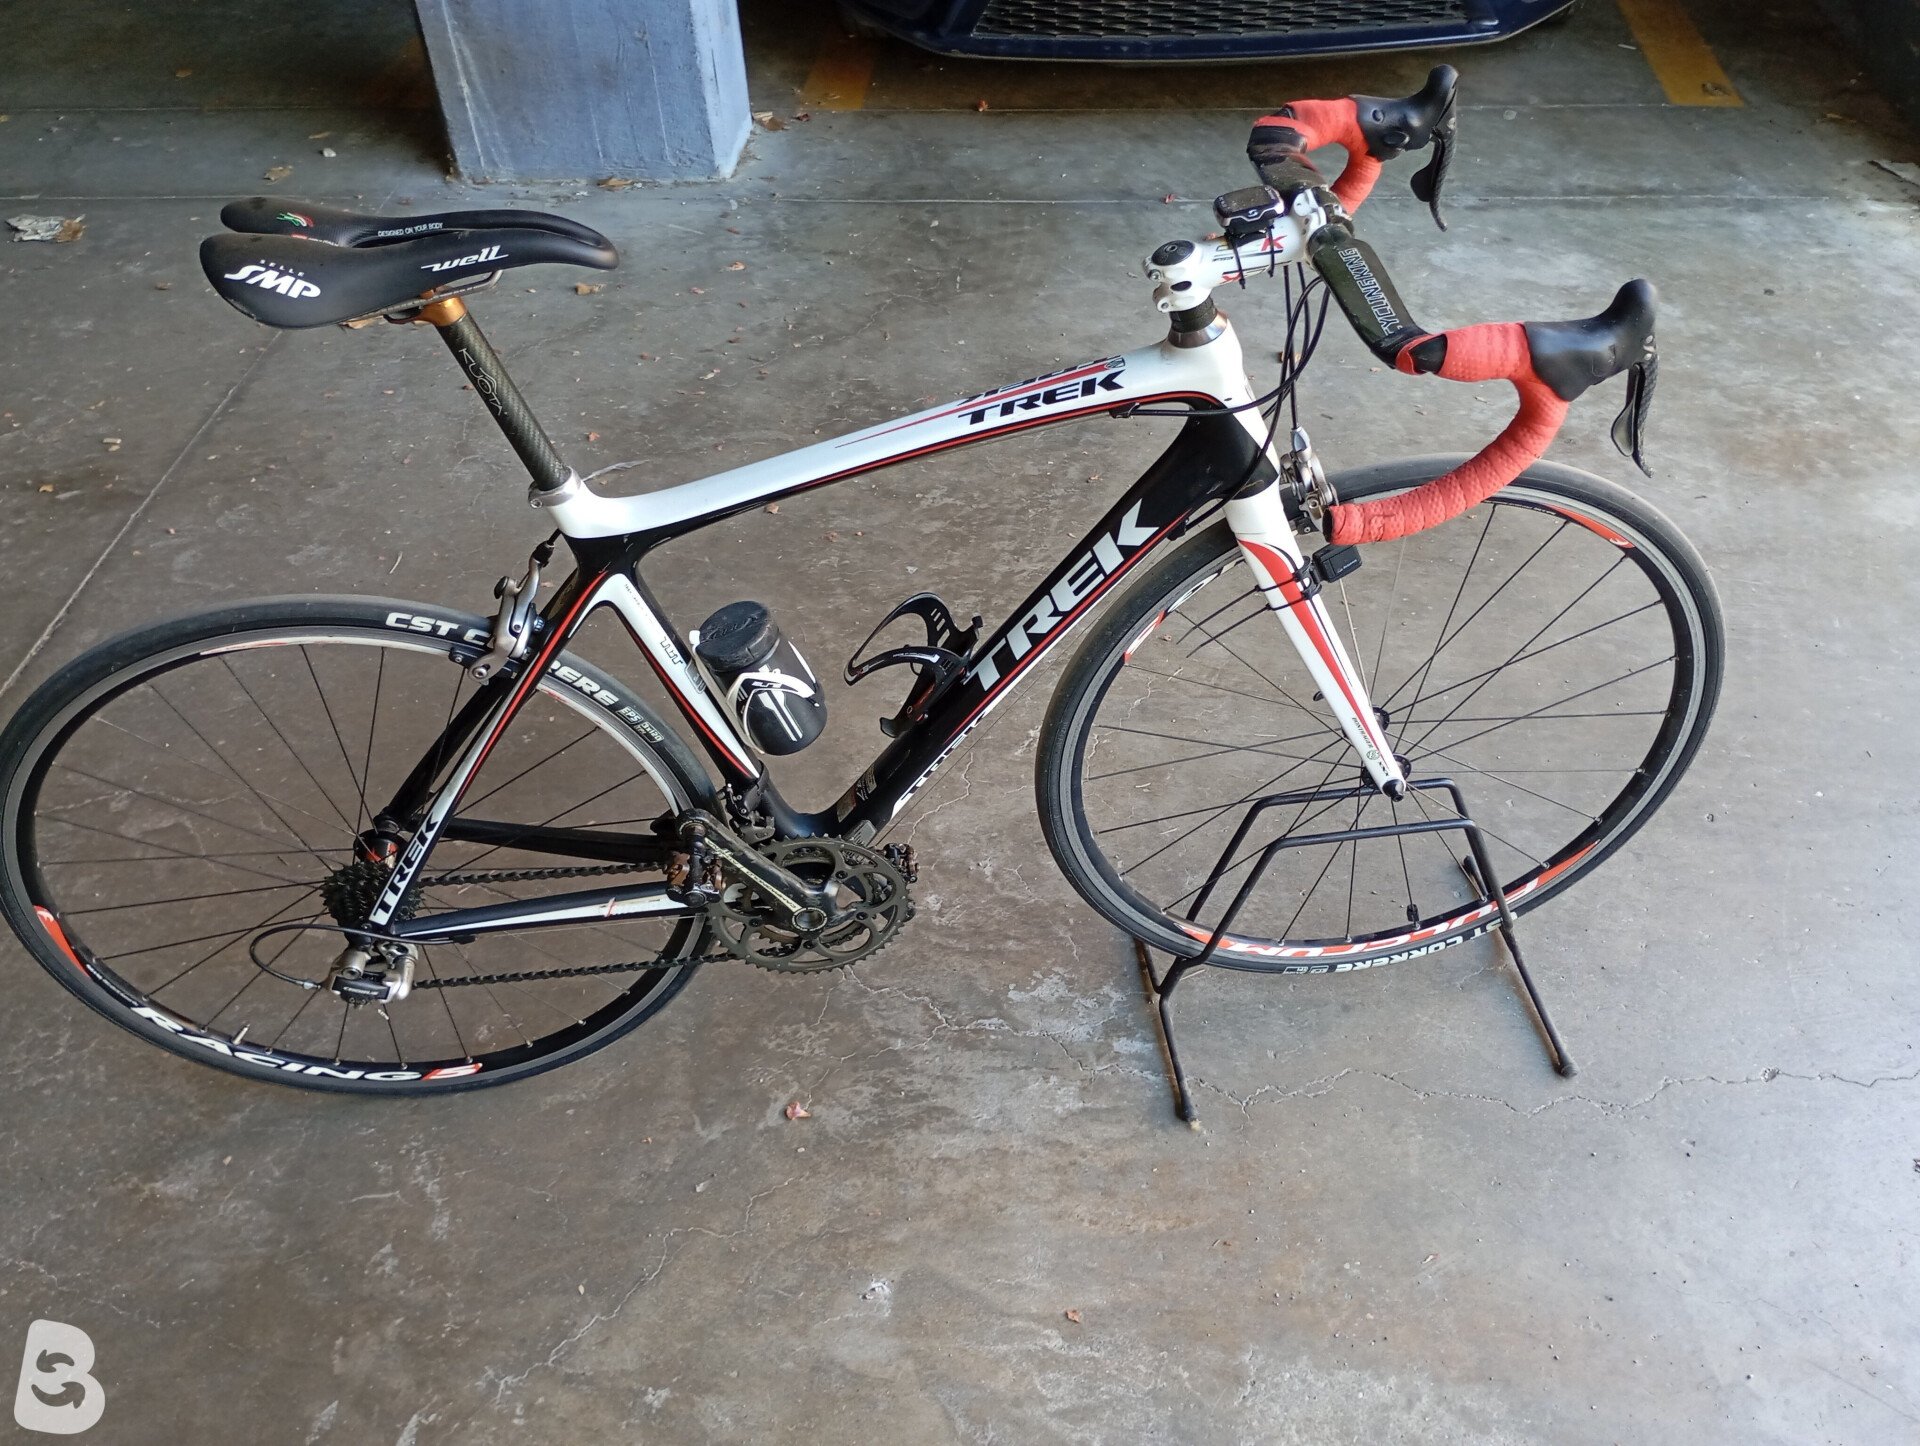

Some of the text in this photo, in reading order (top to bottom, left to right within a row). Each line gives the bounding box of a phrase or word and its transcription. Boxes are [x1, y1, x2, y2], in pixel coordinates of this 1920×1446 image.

[413, 224, 428, 234] YOUR
[428, 222, 443, 230] BODY
[421, 245, 509, 272] well
[224, 265, 321, 298] SMP
[958, 369, 1126, 425] TREK
[964, 498, 1159, 691] TREK
[385, 612, 460, 636] CST
[619, 706, 641, 722] EPS
[373, 812, 440, 916] TREK
[130, 1006, 423, 1082] RACING
